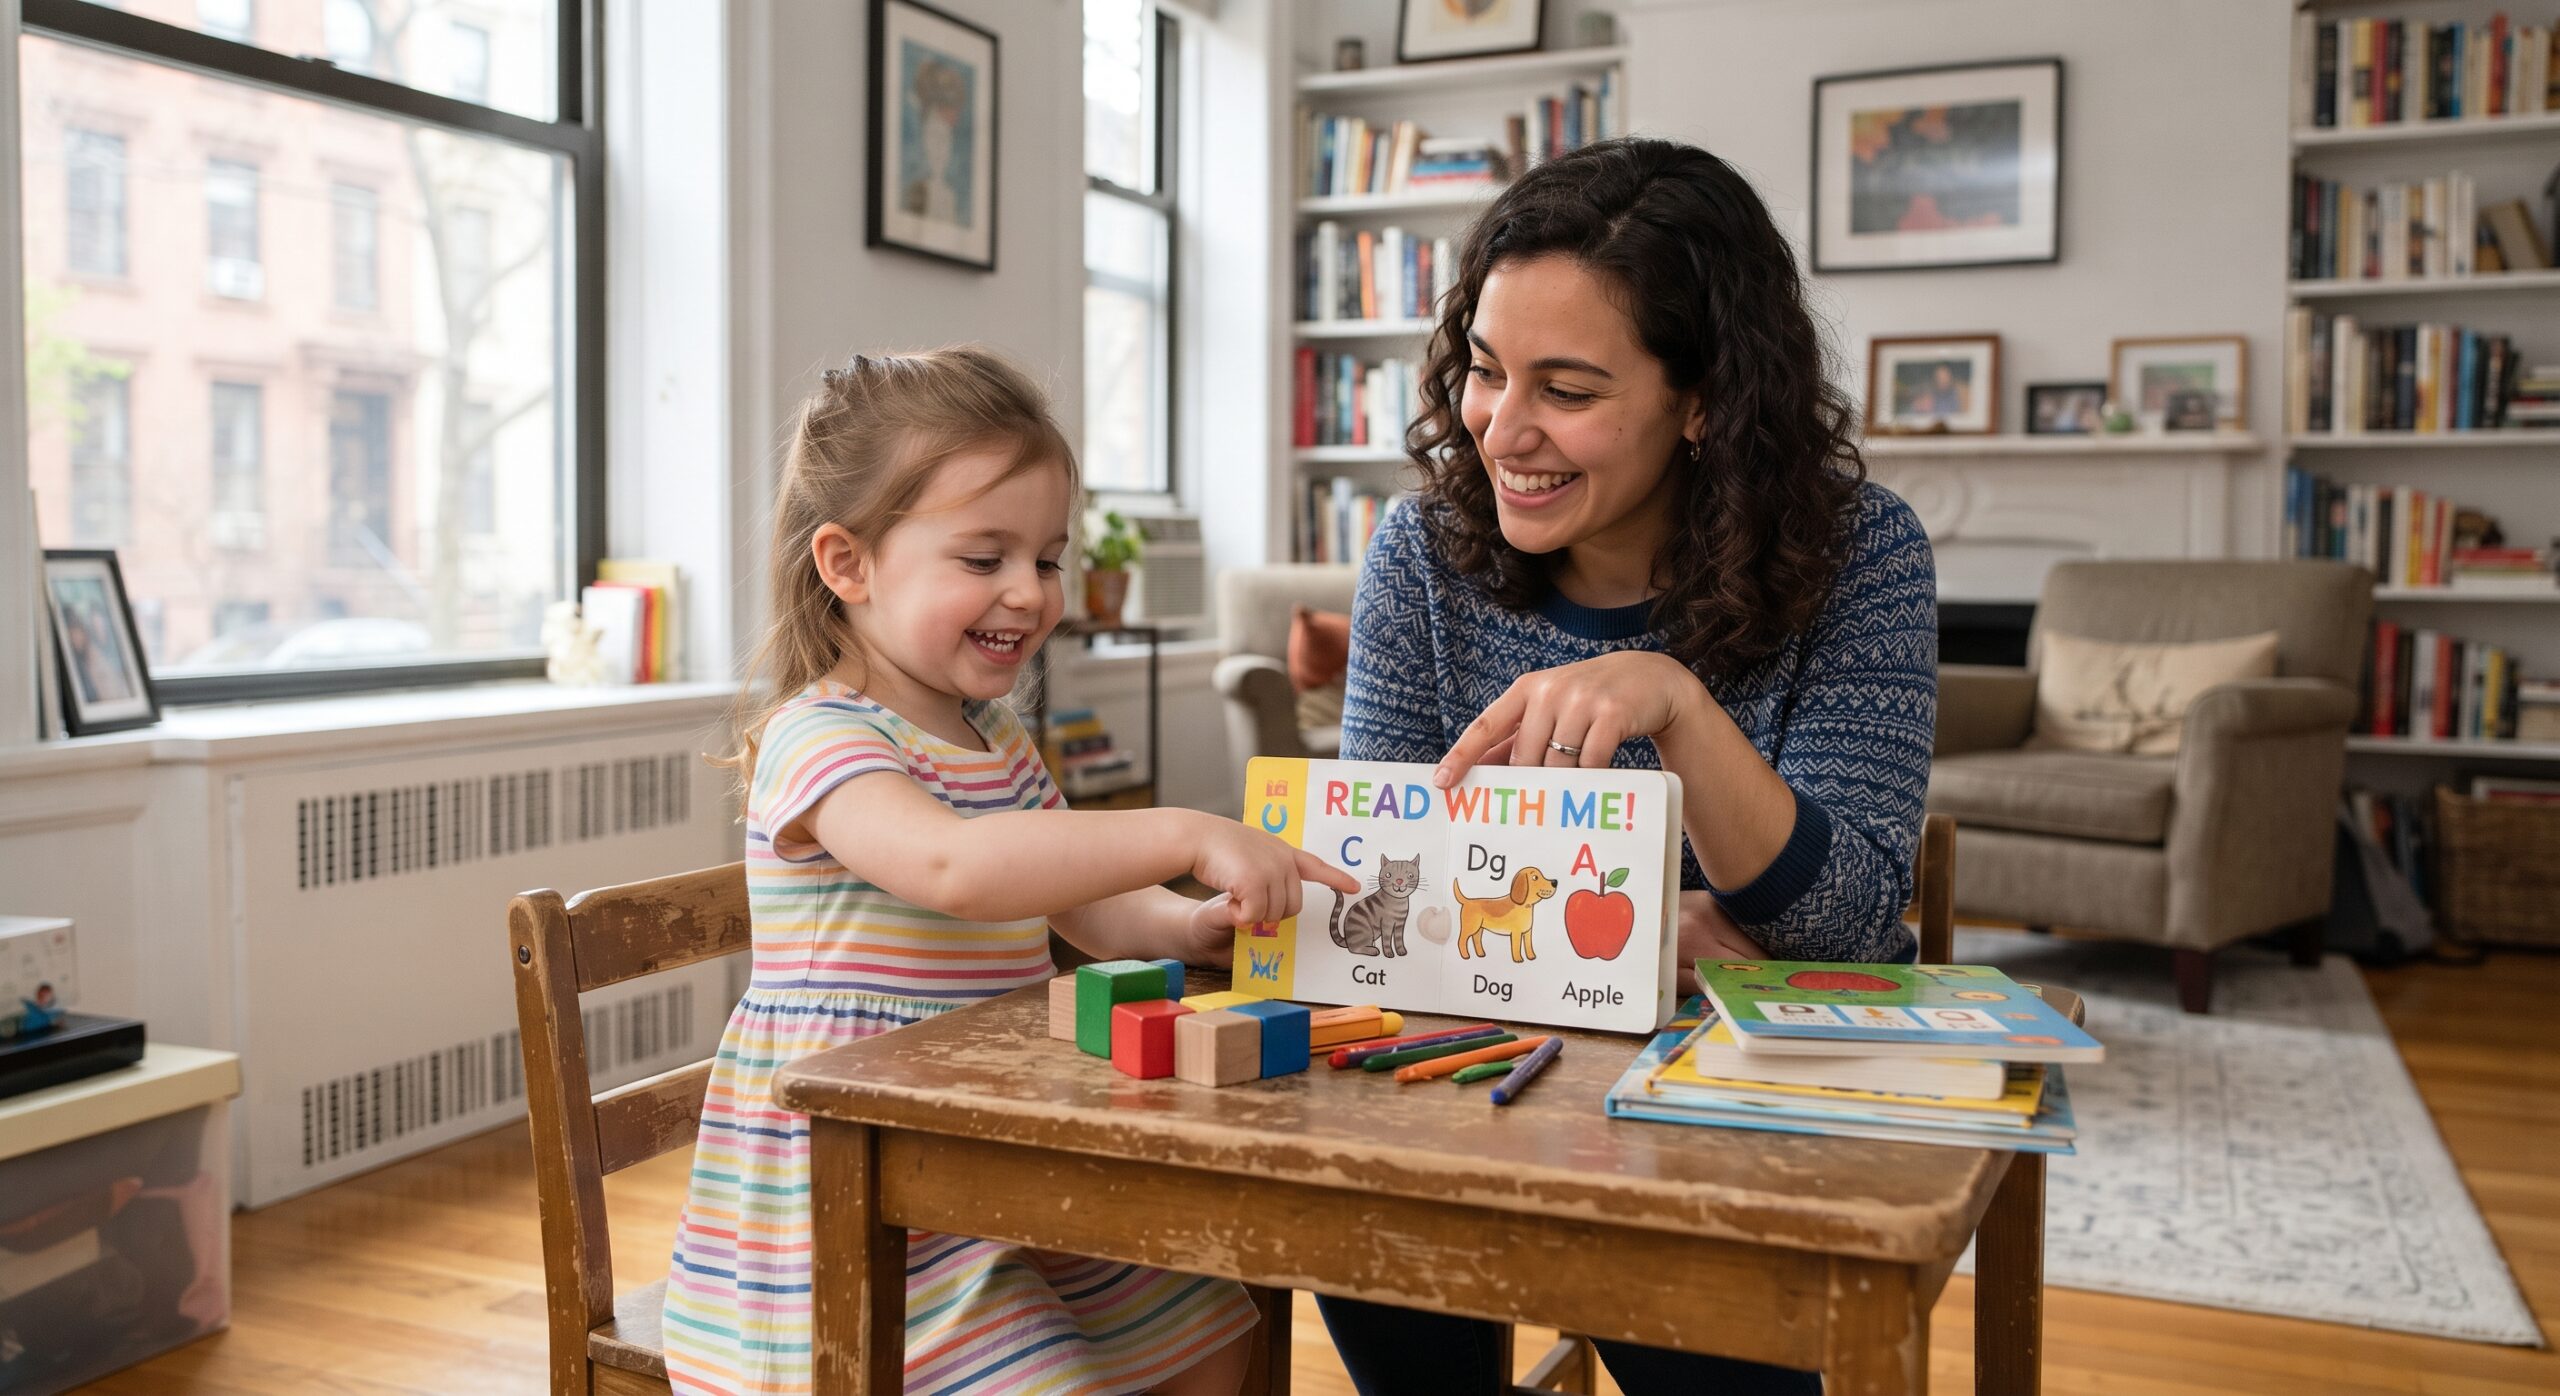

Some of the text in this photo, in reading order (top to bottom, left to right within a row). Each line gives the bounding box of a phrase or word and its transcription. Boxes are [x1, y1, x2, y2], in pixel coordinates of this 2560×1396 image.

[1325, 780, 1636, 831] READ WITH ME!
[1340, 835, 1598, 881] C Dg A
[1351, 964, 1624, 1009] Cat Dog Apple
